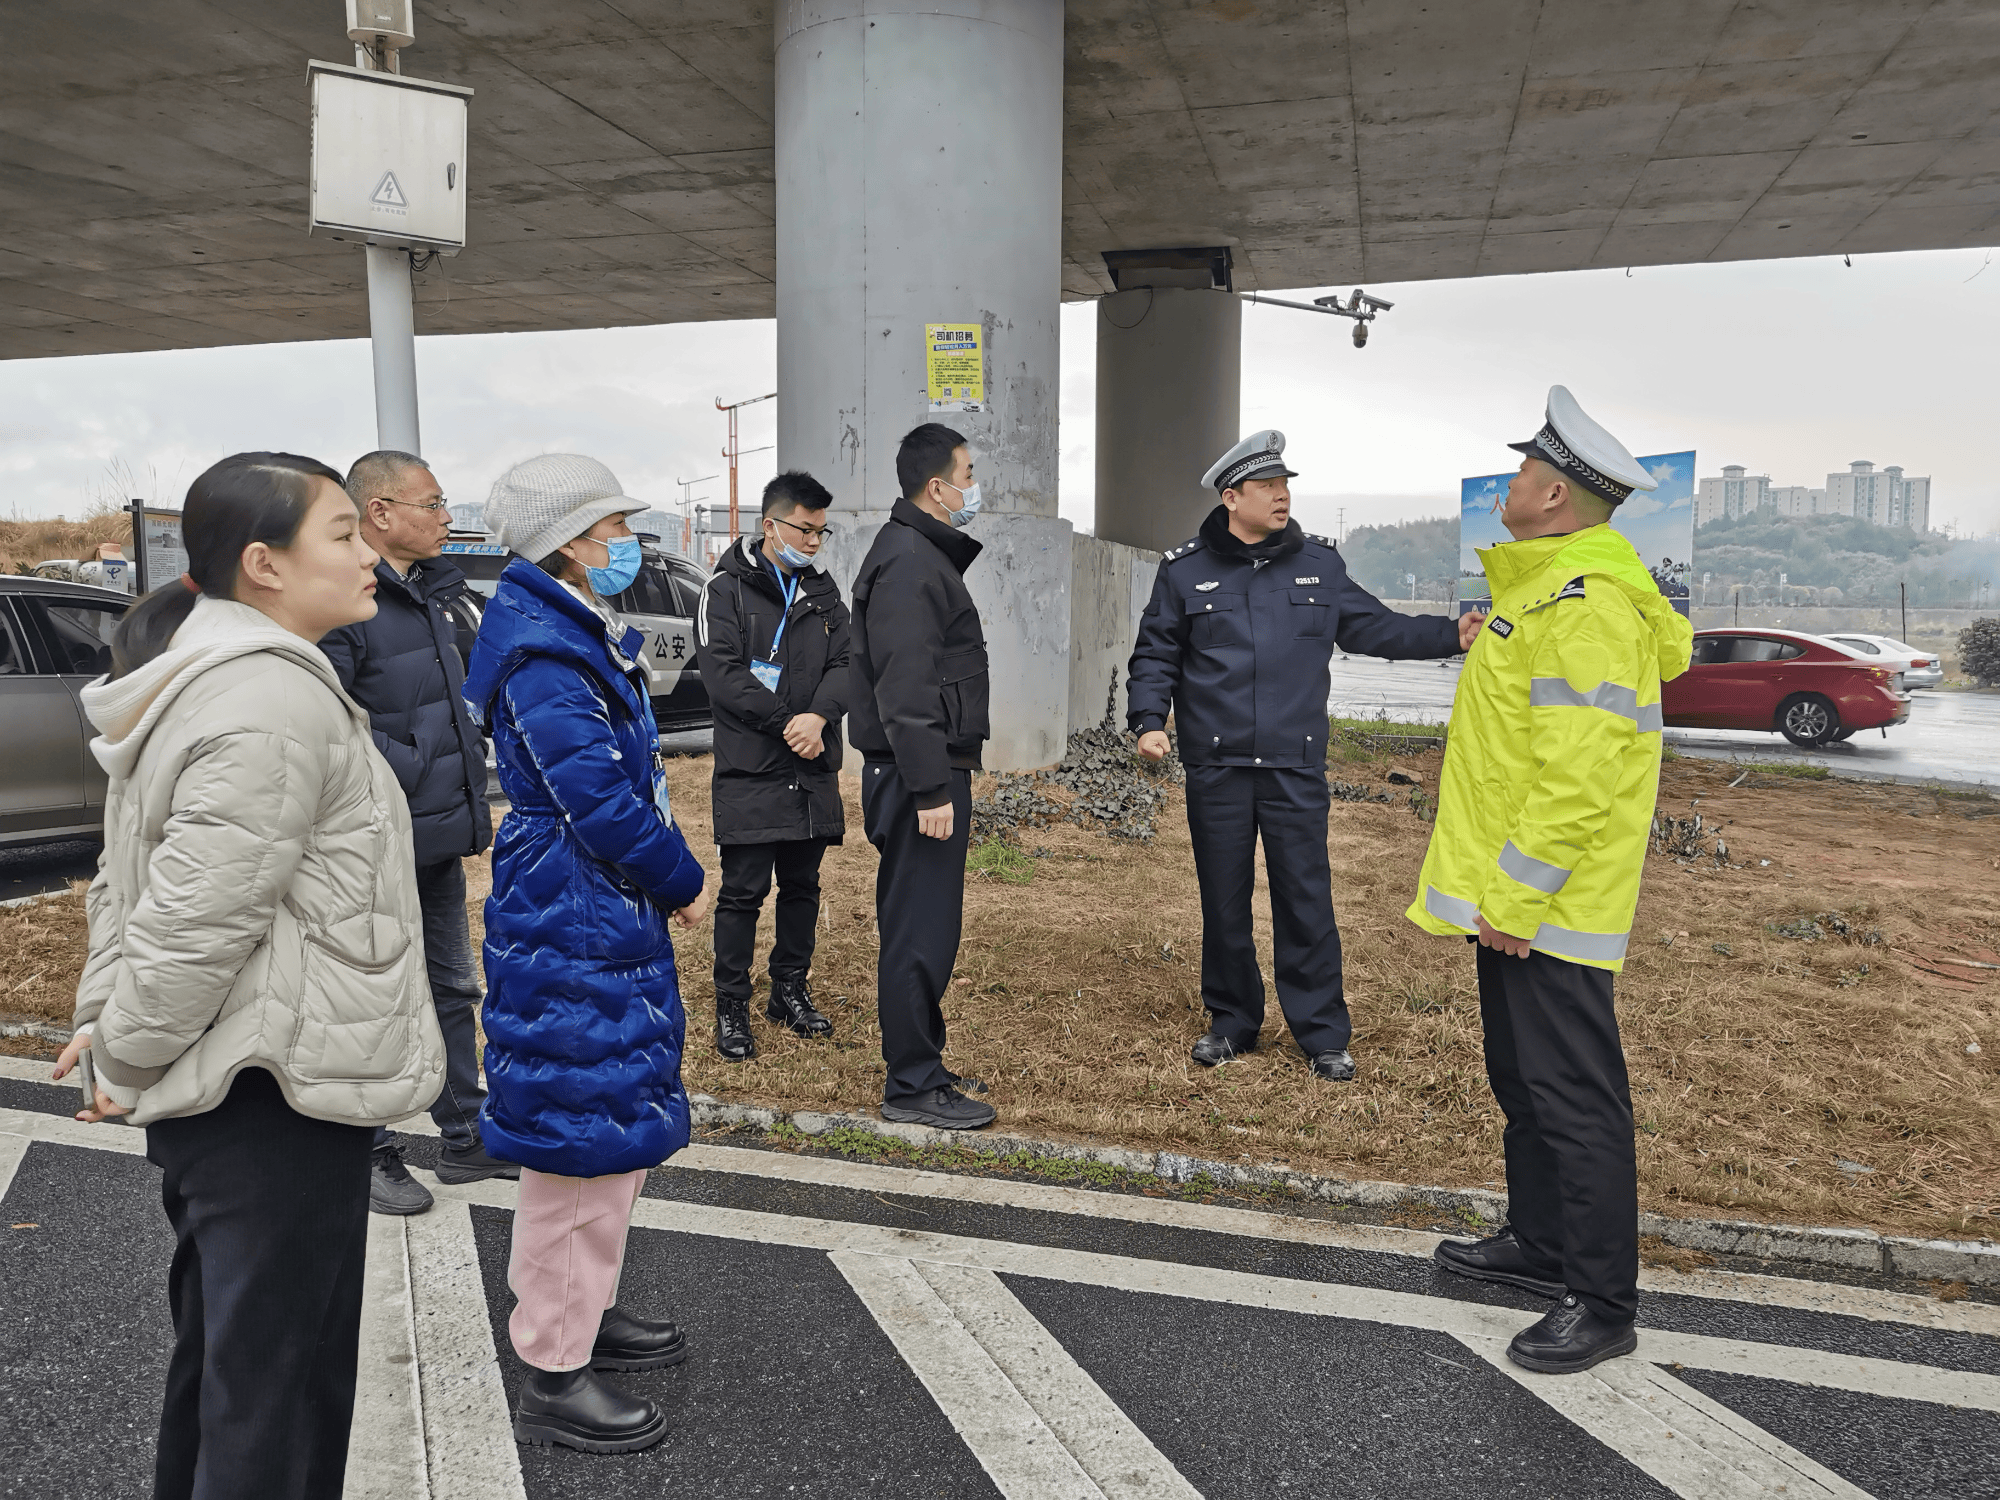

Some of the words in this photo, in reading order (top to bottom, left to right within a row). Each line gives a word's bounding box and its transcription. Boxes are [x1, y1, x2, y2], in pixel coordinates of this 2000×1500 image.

[936, 331, 974, 341] 司机招募
[1295, 576, 1320, 585] 025173
[654, 632, 686, 660] 公安
